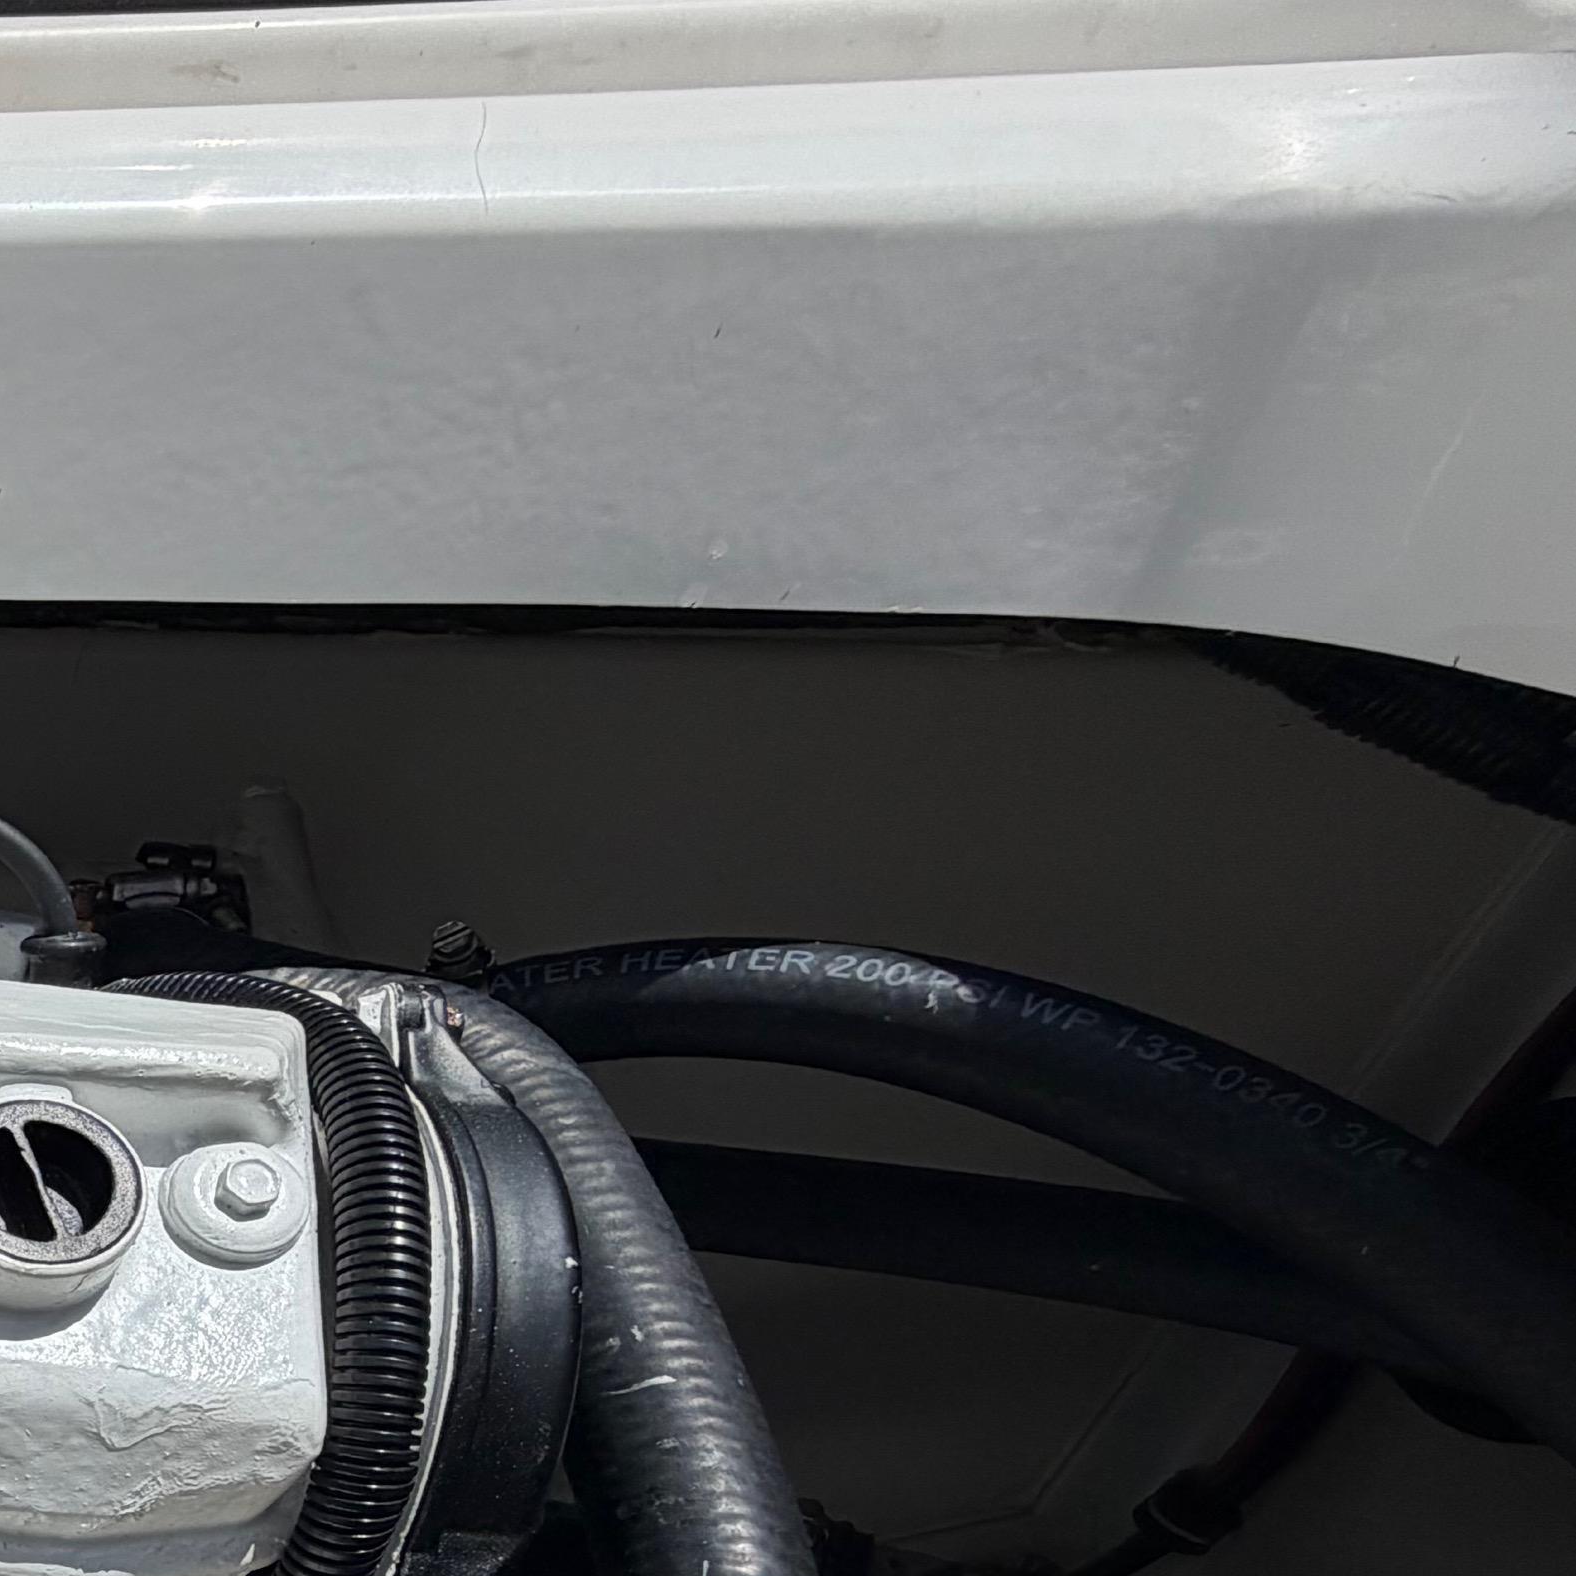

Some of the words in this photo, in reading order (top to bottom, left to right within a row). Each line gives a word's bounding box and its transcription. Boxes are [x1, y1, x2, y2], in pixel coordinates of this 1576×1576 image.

[488, 955, 604, 996] ATER
[620, 946, 817, 976] HEATER
[825, 953, 911, 987] 200
